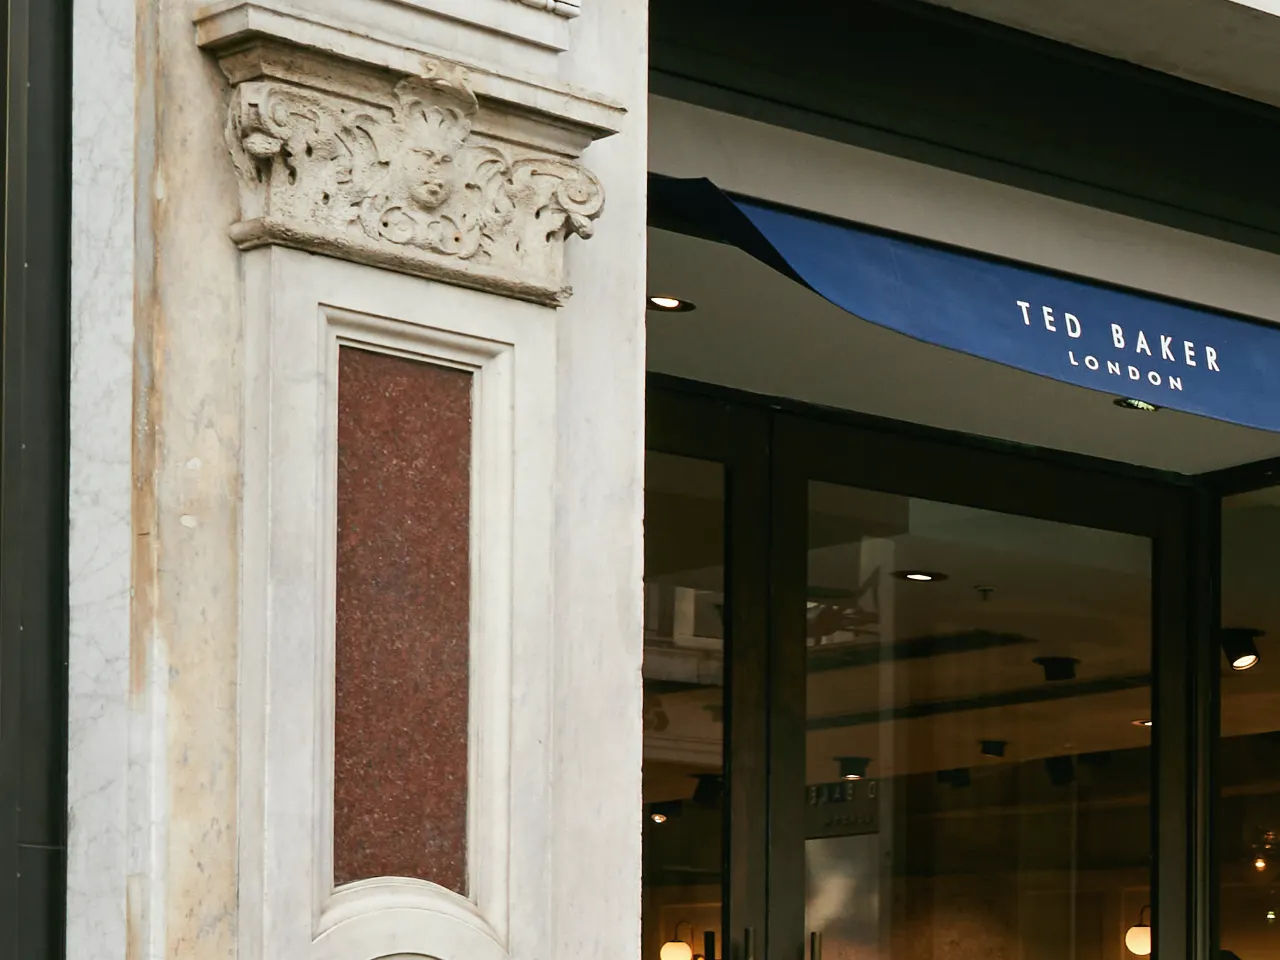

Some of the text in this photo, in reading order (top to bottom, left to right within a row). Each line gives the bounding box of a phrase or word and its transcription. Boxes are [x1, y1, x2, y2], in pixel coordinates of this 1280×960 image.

[1016, 300, 1220, 372] TED BAKER
[1068, 350, 1183, 391] LONDON
